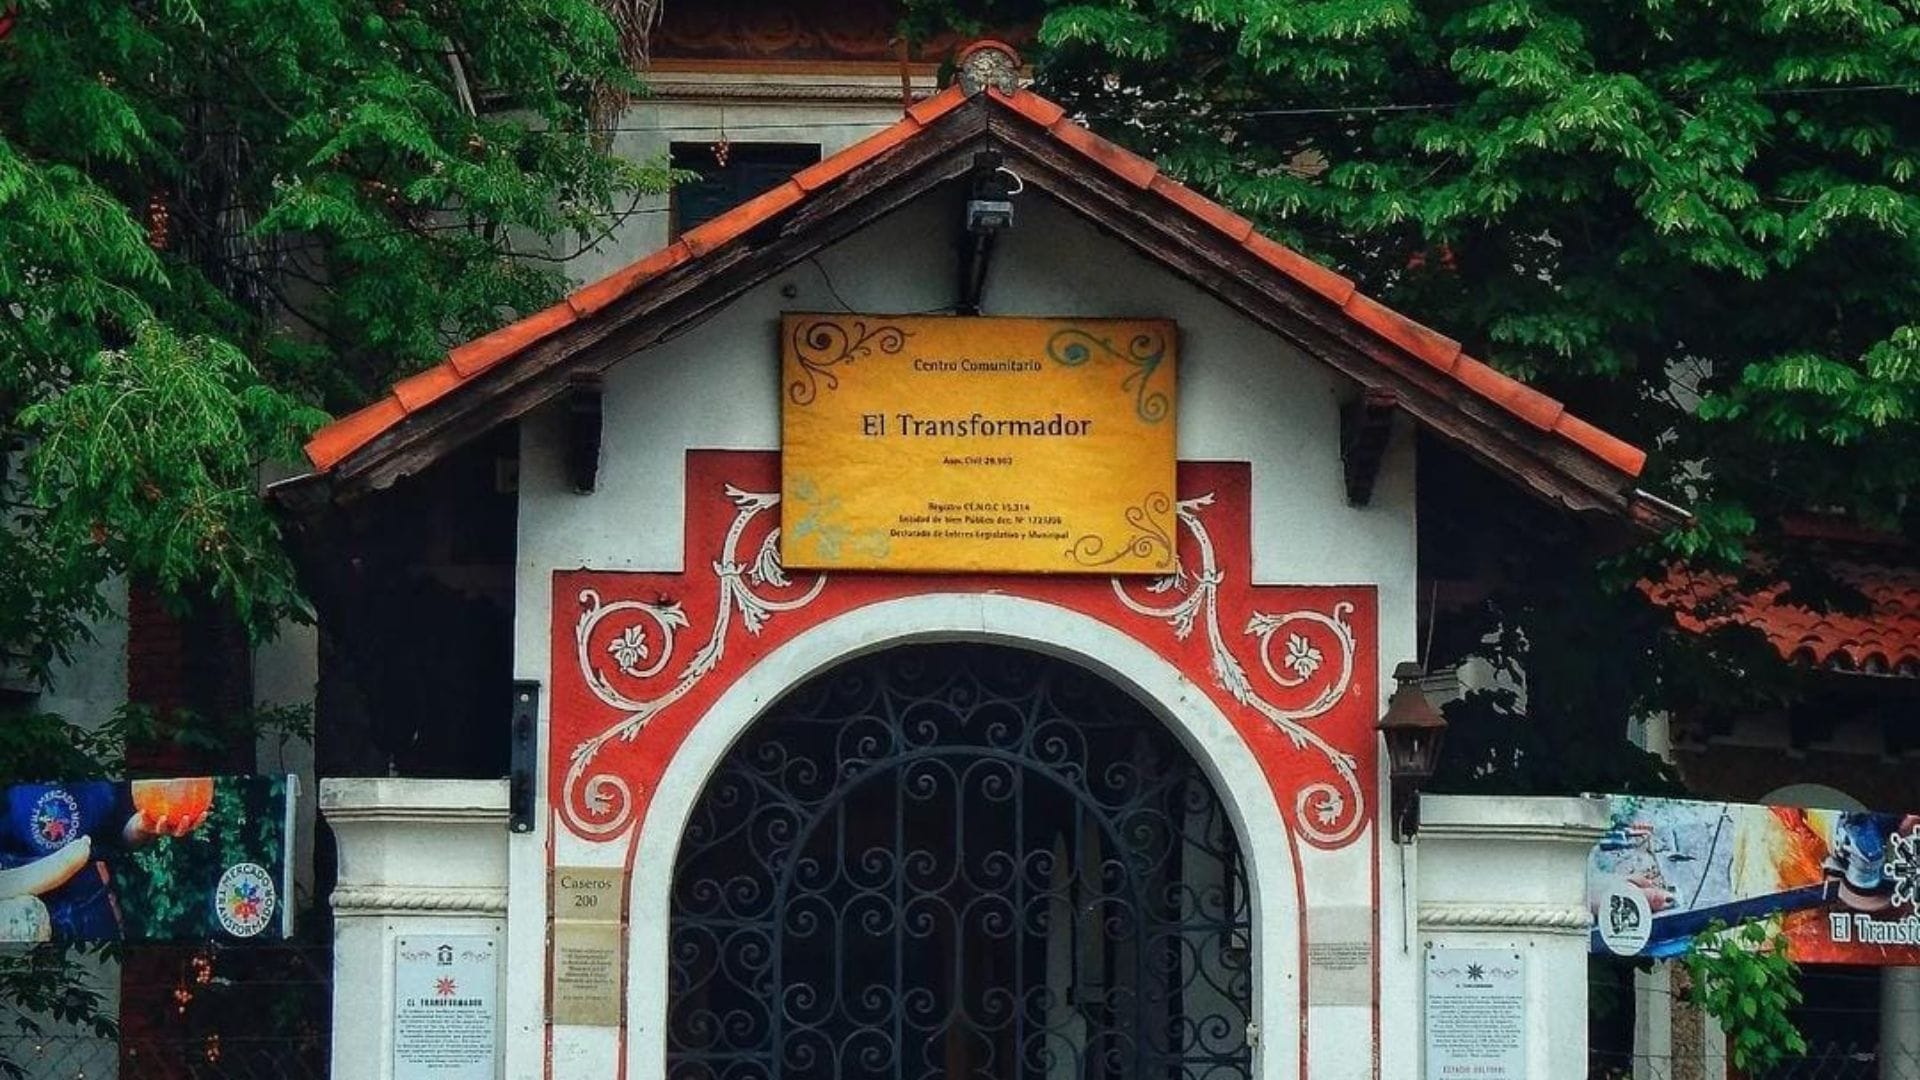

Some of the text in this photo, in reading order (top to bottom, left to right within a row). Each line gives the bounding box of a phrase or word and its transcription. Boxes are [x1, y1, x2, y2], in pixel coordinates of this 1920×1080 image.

[914, 358, 1042, 372] Centro Comunitario
[863, 413, 1092, 437] El Transformador
[928, 502, 962, 512] Registro
[899, 515, 931, 523] Entidad
[932, 515, 942, 523] de
[890, 528, 931, 538] Declarado
[933, 529, 942, 538] de
[1028, 530, 1069, 541] Municipal
[561, 876, 613, 890] Caseros
[574, 895, 599, 908] 200
[218, 889, 274, 935] TRANSFORMADOR
[1829, 913, 1850, 941] El
